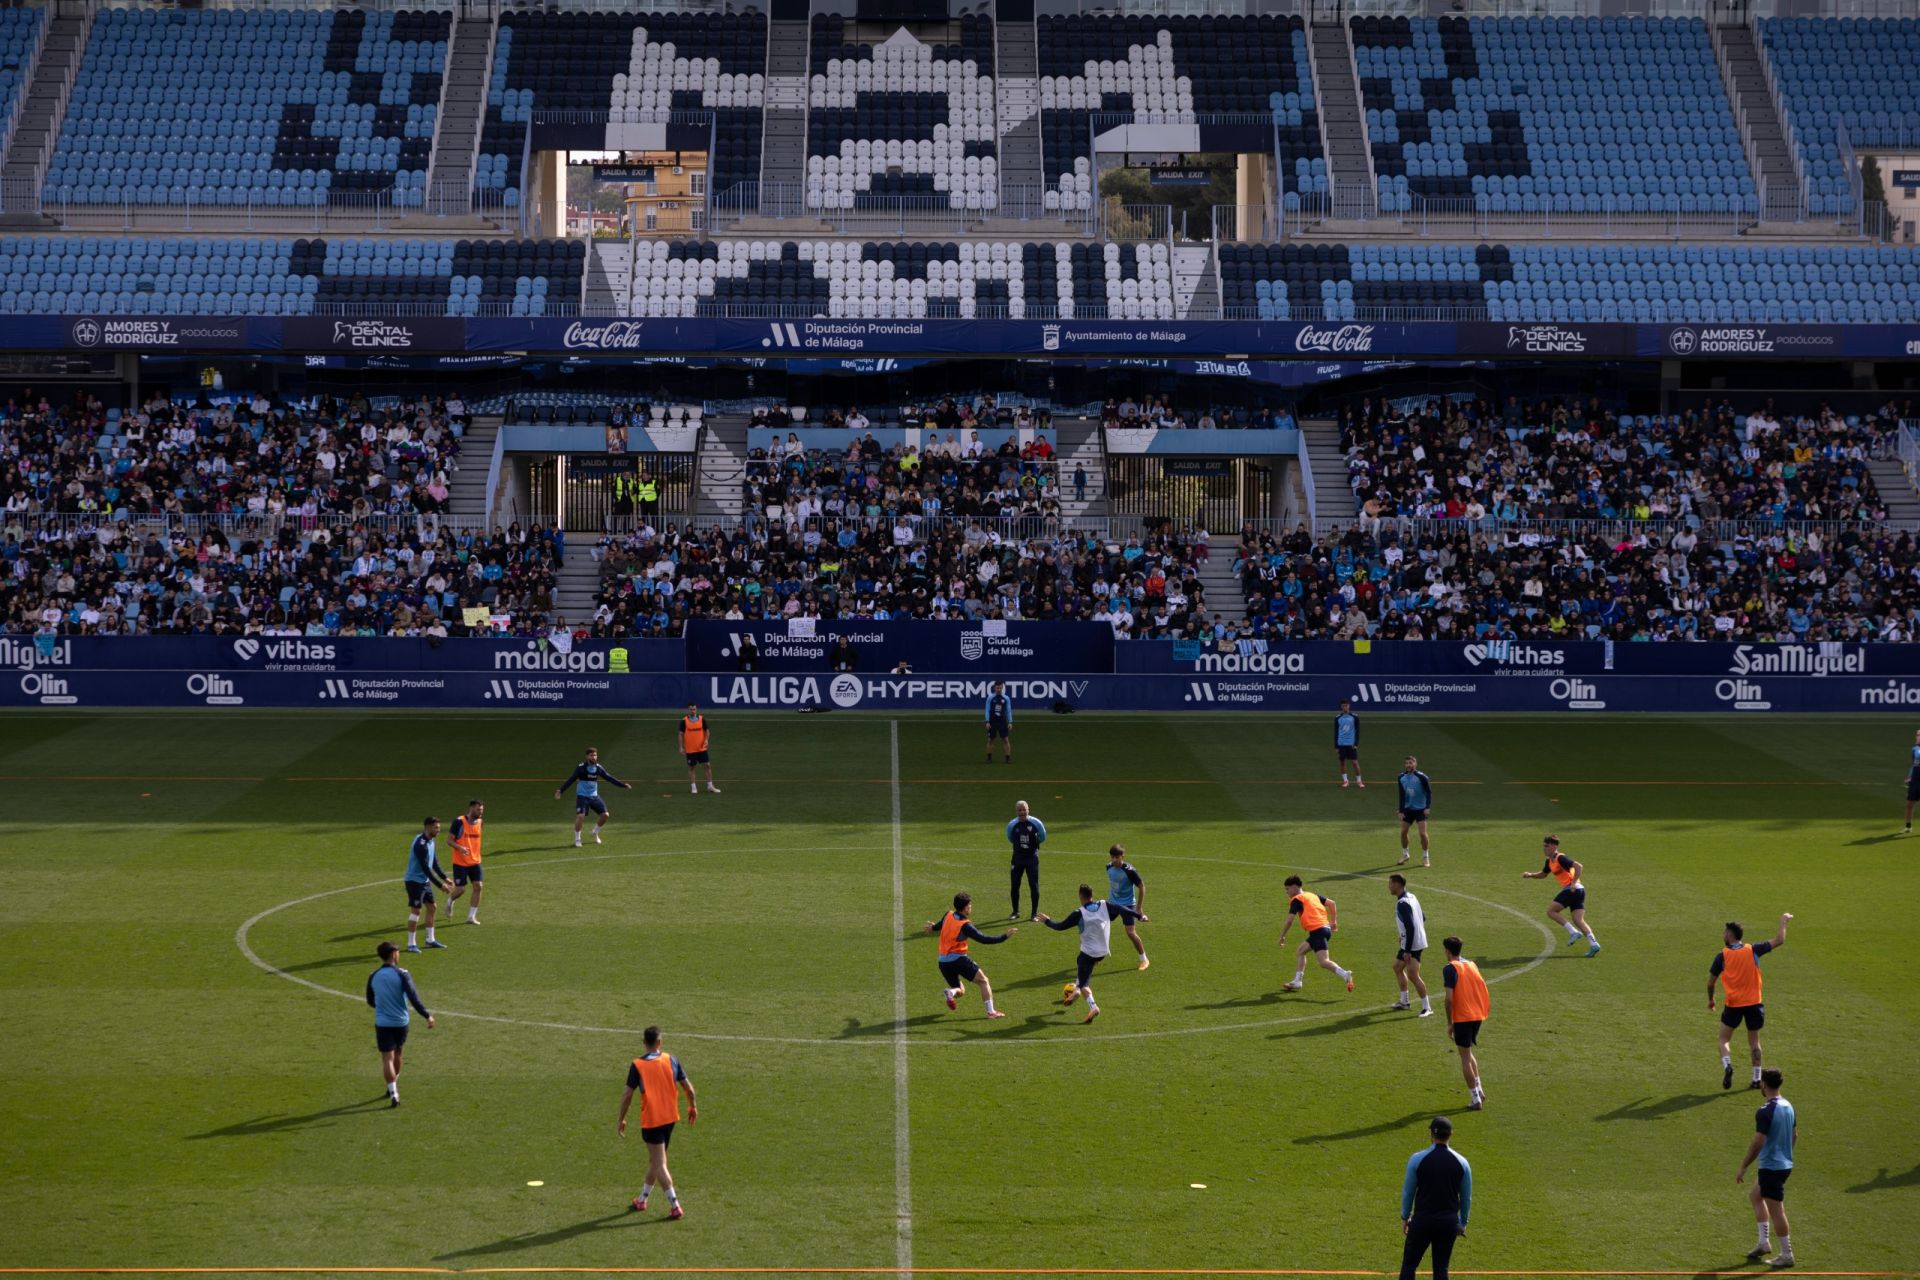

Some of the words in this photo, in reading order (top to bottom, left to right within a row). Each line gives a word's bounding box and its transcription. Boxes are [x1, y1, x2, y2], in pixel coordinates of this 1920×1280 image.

[601, 168, 627, 176] SALIDA
[632, 168, 648, 176] EXIT
[104, 322, 159, 332] AMORES
[161, 322, 170, 332] Y
[352, 326, 413, 336] DENTAL
[805, 324, 866, 336] Diputación
[868, 324, 923, 334] Provincial
[181, 328, 238, 337] PODÓLOGOS
[564, 321, 643, 348] Coca-Cola
[1065, 331, 1132, 342] Ayuntamiento
[1136, 332, 1148, 340] de
[1150, 331, 1186, 342] Málaga
[1526, 332, 1587, 340] DENTAL
[1700, 330, 1754, 340] AMORES
[1757, 330, 1766, 339] Y
[104, 332, 179, 344] RODRÍGUEZ
[352, 336, 411, 346] CLINICS
[1296, 324, 1376, 352] Coca-Cola
[1776, 336, 1834, 344] PODÓLOGOS
[805, 337, 820, 347] de
[822, 337, 864, 350] Málaga
[1526, 342, 1584, 352] CLINICS
[1701, 339, 1774, 352] RODRÍGUEZ
[1174, 462, 1200, 470] SALIDA
[1206, 462, 1222, 470] EXIT
[764, 632, 826, 644] Diputación
[828, 633, 884, 643] Prvincial
[988, 637, 1020, 646] Ciudad
[265, 640, 336, 660] vithas
[764, 647, 780, 656] de
[782, 646, 824, 659] Málaga
[1001, 647, 1034, 656] Málaga
[1498, 646, 1564, 664] ithas
[1494, 668, 1510, 676] vivir
[1532, 668, 1564, 676] cuidarte
[21, 674, 68, 694] Olin
[186, 674, 234, 694] Olin
[352, 680, 400, 690] Diputación
[402, 680, 444, 688] Provincial
[518, 680, 564, 690] Diputación
[566, 680, 610, 688] Provincial
[836, 682, 856, 692] EA
[1218, 682, 1265, 692] Diputación
[1267, 682, 1310, 691] Provincial
[1385, 684, 1432, 692] Diputación
[1434, 684, 1476, 692] Provincial
[1550, 678, 1596, 700] Olin
[352, 690, 364, 698] de
[366, 690, 398, 700] Málaga
[518, 691, 528, 699] de
[531, 690, 564, 700] Málaga
[712, 676, 822, 704] LALIGA
[1715, 680, 1762, 700] Olin
[1231, 693, 1264, 703] Málaga
[1384, 694, 1396, 702] de
[1398, 694, 1430, 704] Málaga
